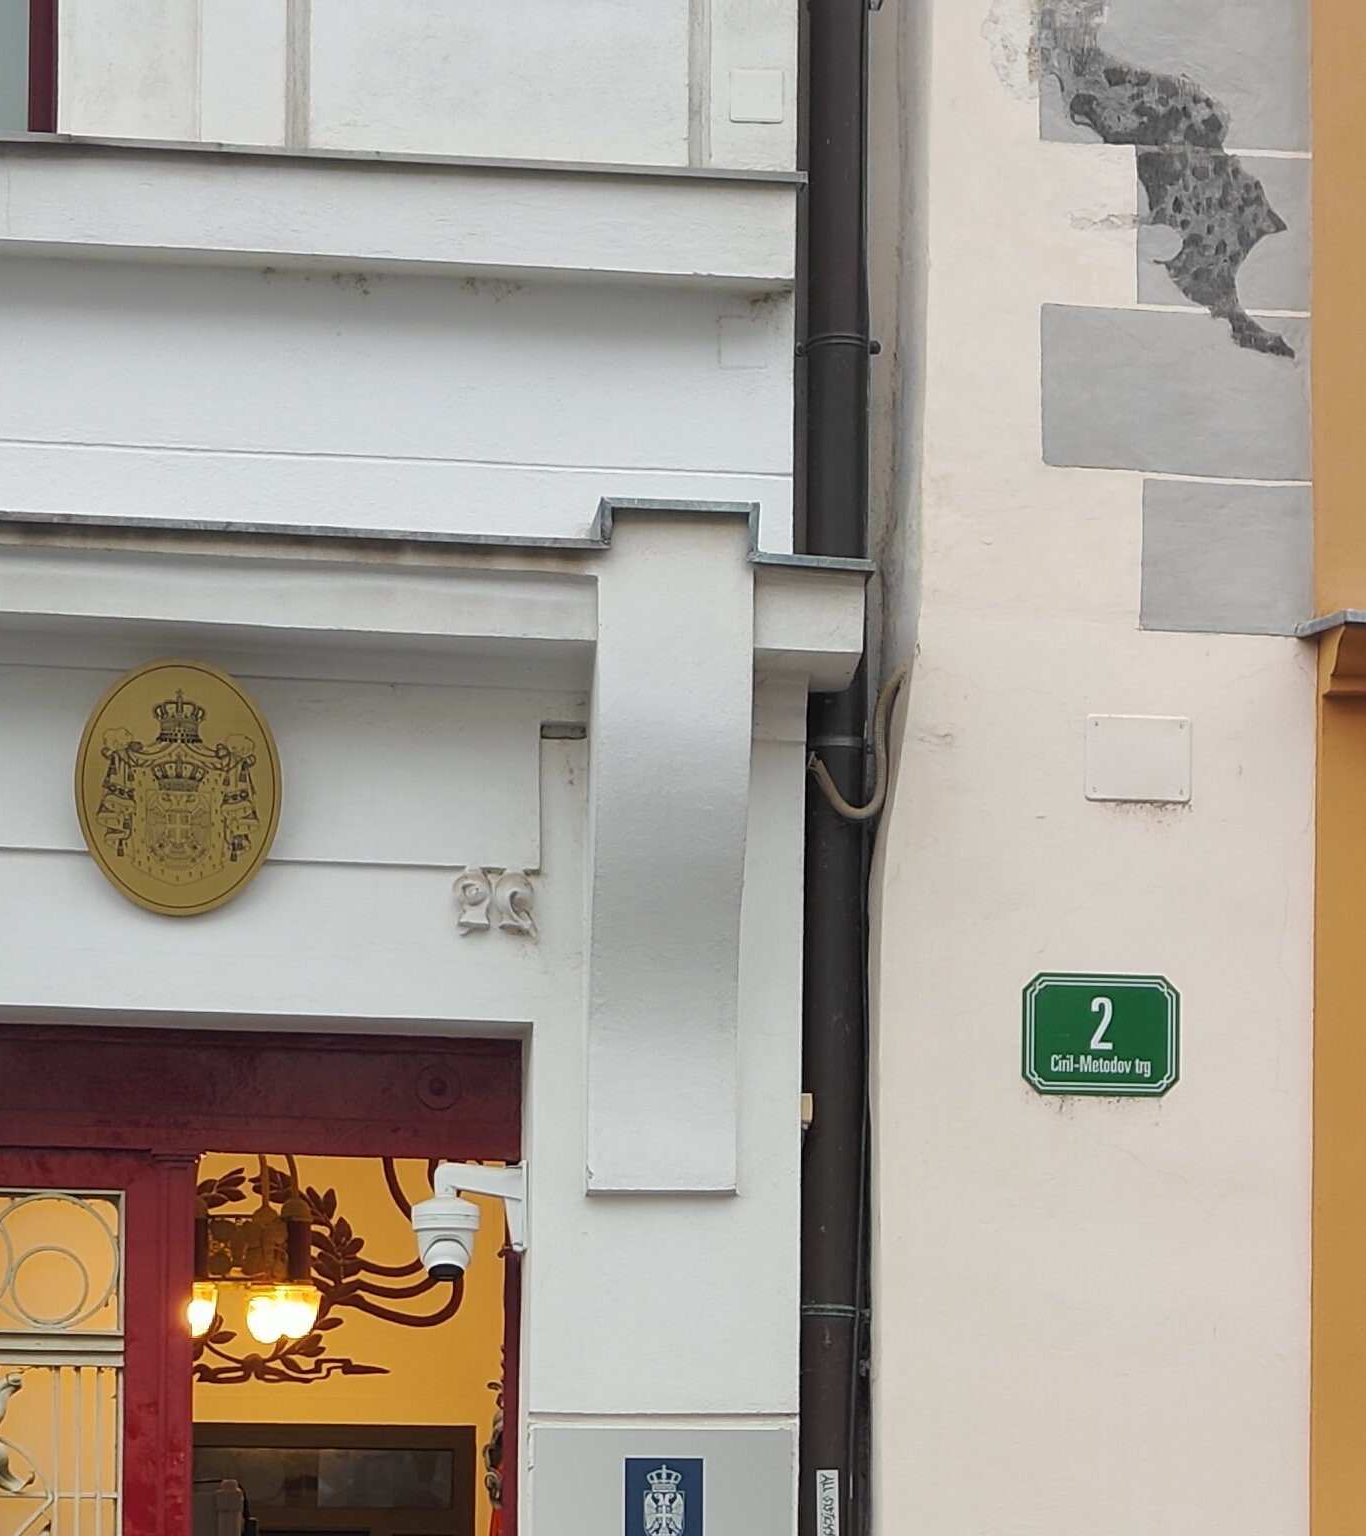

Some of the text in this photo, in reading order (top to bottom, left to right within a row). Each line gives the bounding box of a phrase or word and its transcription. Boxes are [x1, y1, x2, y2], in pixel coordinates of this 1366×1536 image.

[1090, 996, 1114, 1050] 2
[1050, 1054, 1151, 1078] Ciril-Metodov trg
